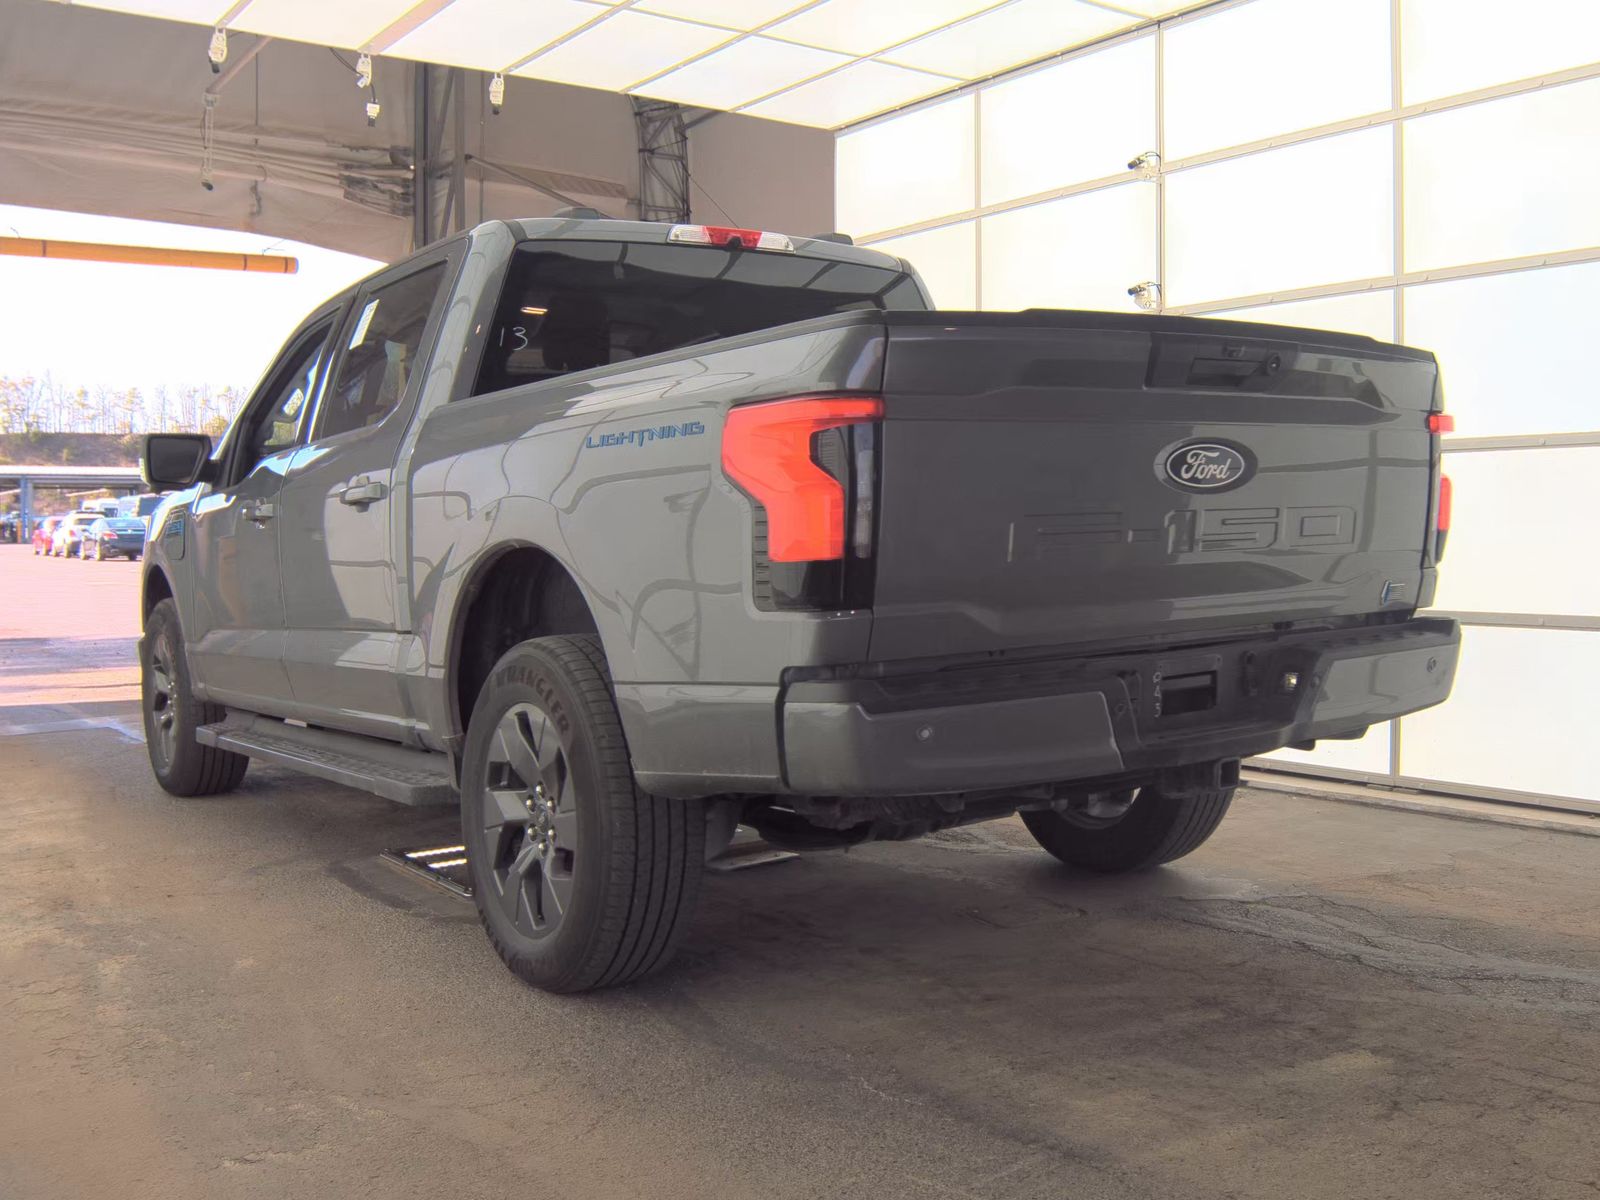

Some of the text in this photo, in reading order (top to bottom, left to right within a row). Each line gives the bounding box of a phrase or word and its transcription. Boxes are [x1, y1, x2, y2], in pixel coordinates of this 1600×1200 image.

[499, 326, 529, 351] 13
[586, 421, 705, 448] LIGHTNING
[1180, 449, 1232, 479] Ford
[1007, 506, 1358, 563] F-150
[495, 664, 570, 735] WRANGLER
